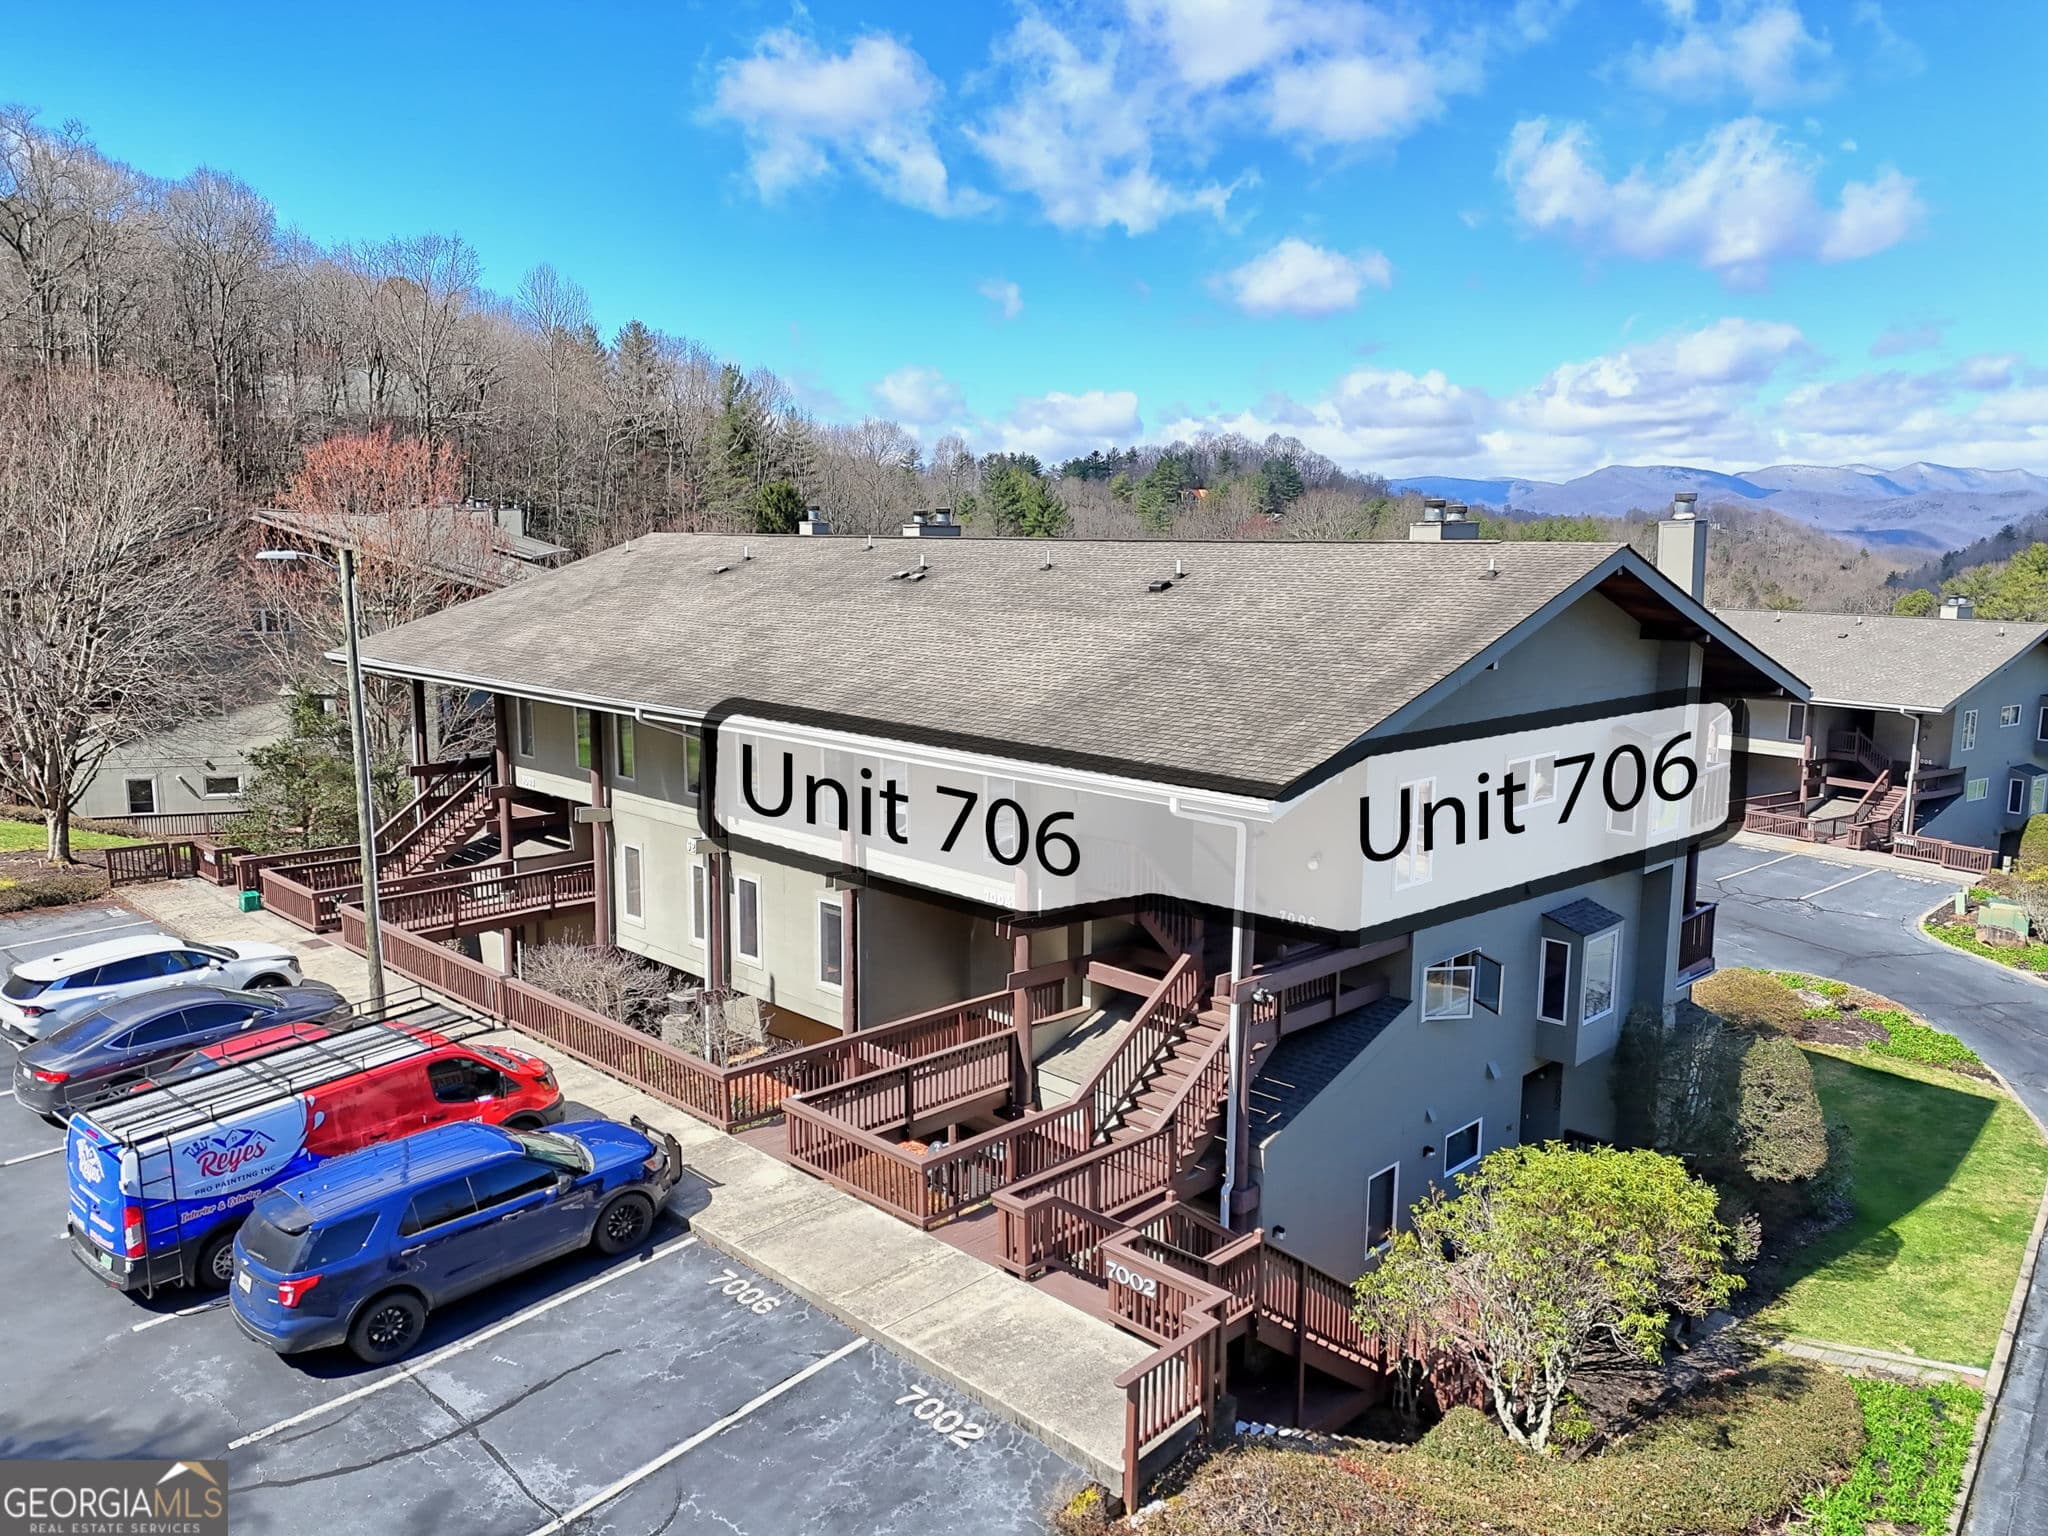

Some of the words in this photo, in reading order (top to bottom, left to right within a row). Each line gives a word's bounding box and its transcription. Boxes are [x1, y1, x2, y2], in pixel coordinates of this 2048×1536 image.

[196, 1141, 266, 1177] Reyes
[194, 1185, 213, 1196] PRO
[215, 1171, 258, 1190] PAINTING
[260, 1164, 276, 1175] INC
[181, 1205, 216, 1224] Interior
[707, 1268, 781, 1314] 7006
[1105, 1260, 1157, 1299] 7002
[894, 1384, 985, 1450] 7002
